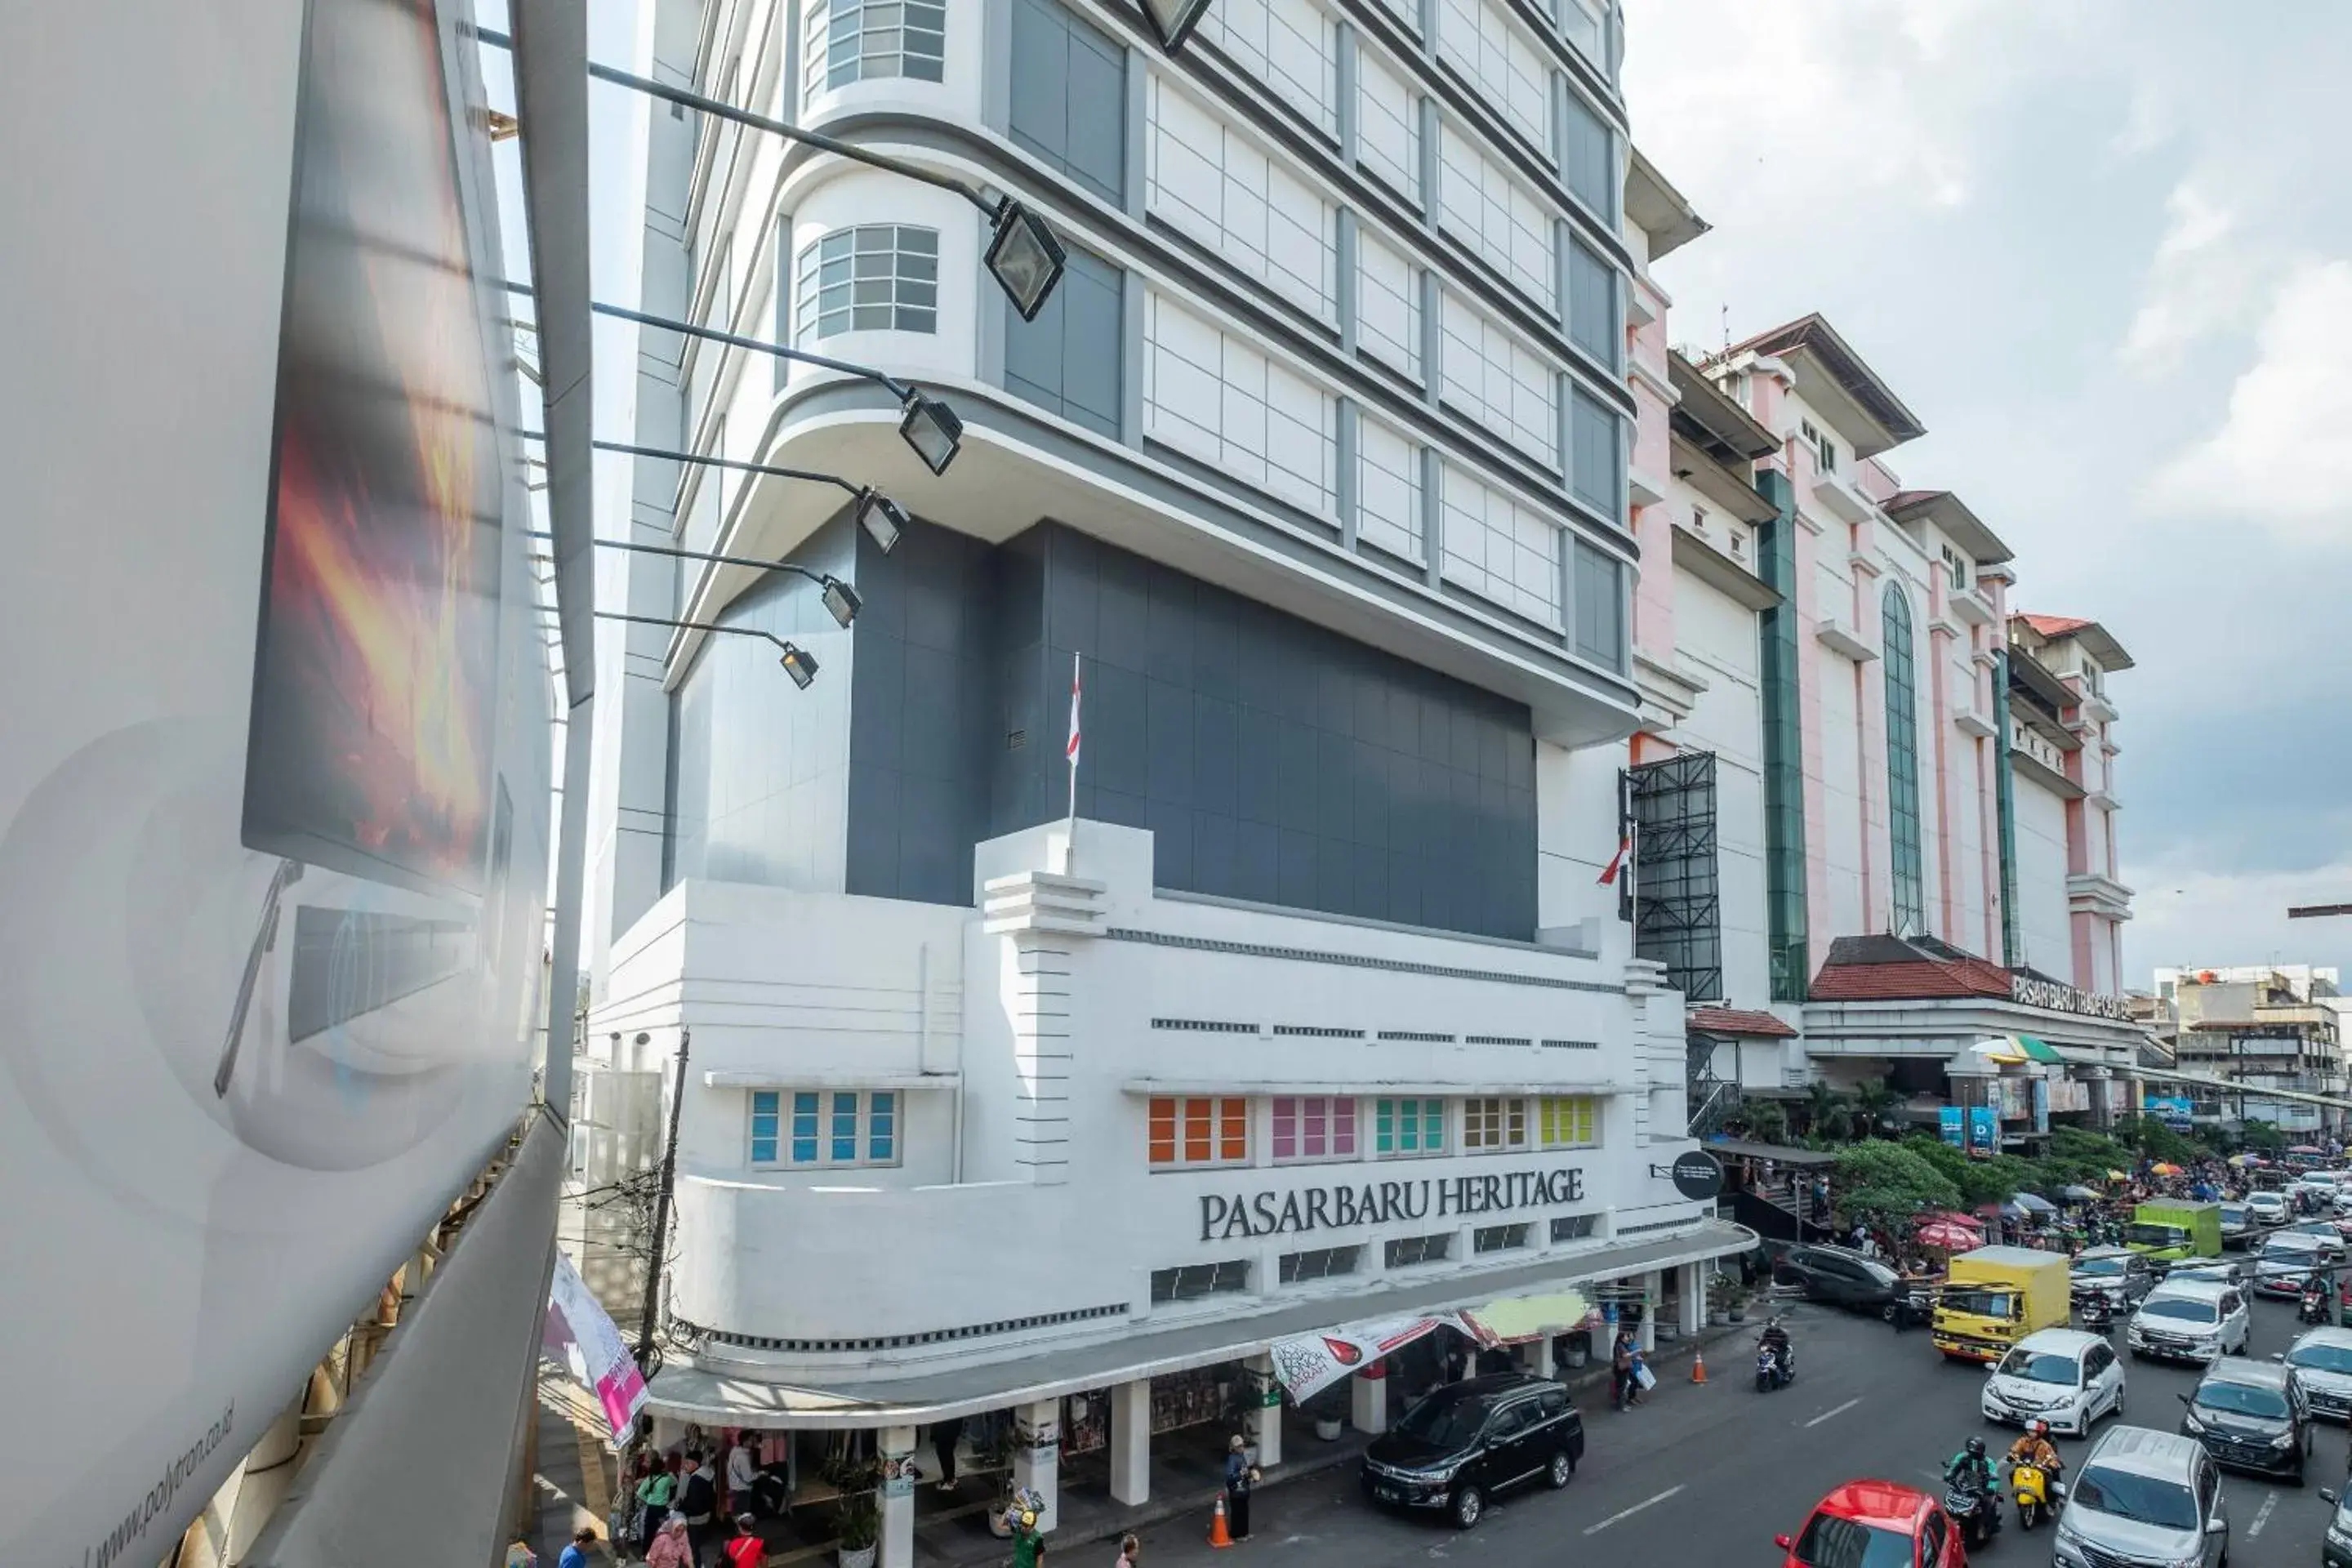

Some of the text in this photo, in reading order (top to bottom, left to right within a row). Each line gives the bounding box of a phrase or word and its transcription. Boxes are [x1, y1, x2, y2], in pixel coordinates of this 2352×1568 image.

[2013, 974, 2048, 1009] PASAR
[2049, 982, 2075, 1012] BARU
[1438, 1168, 1584, 1217] HERITAGE
[96, 1395, 235, 1568] www.polytron.co.id
